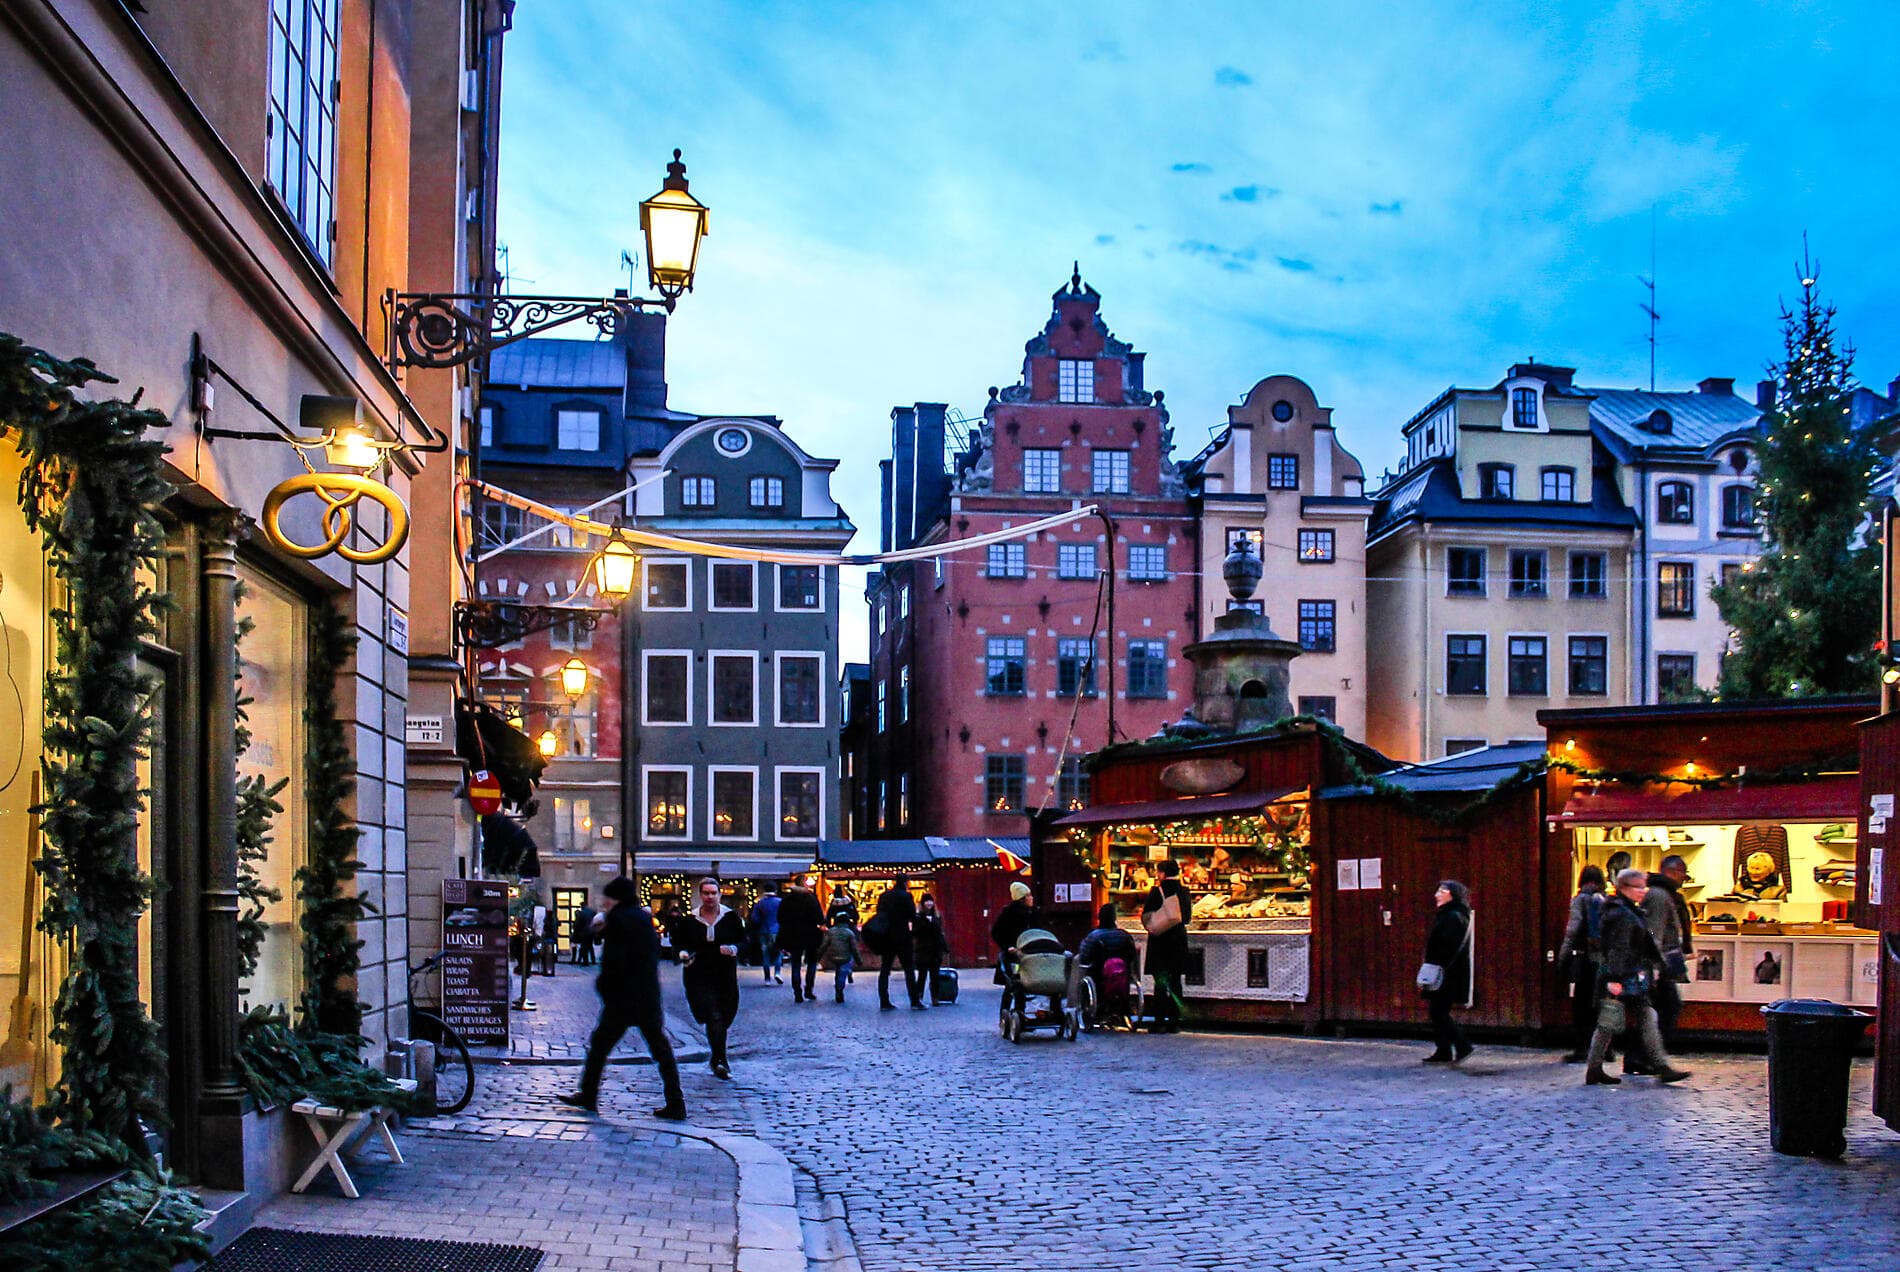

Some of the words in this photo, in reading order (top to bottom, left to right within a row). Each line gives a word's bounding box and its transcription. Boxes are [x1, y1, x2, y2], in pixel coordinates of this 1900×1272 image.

[446, 933, 483, 945] LUNCH
[446, 988, 480, 996] CIABATTA
[446, 1006, 492, 1014] SANDWICHES
[446, 1016, 461, 1024] HOT
[463, 1016, 502, 1024] BEVERAGES
[467, 1026, 506, 1034] BEVERAGES
